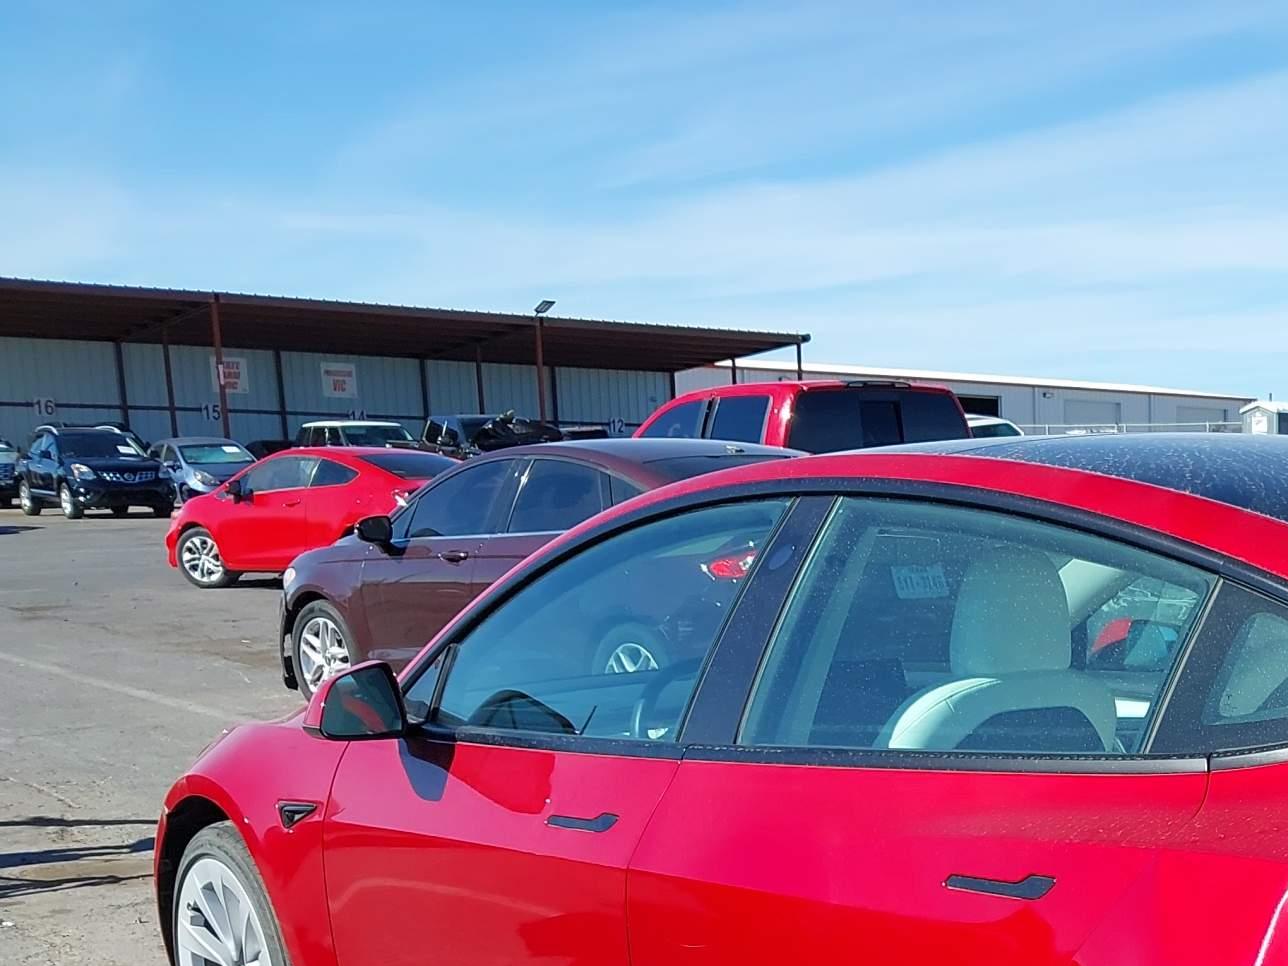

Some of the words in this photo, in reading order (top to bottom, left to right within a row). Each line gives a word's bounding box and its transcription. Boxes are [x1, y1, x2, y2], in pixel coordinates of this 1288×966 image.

[35, 399, 54, 416] 16
[202, 404, 221, 421] 15
[612, 418, 624, 433] 12
